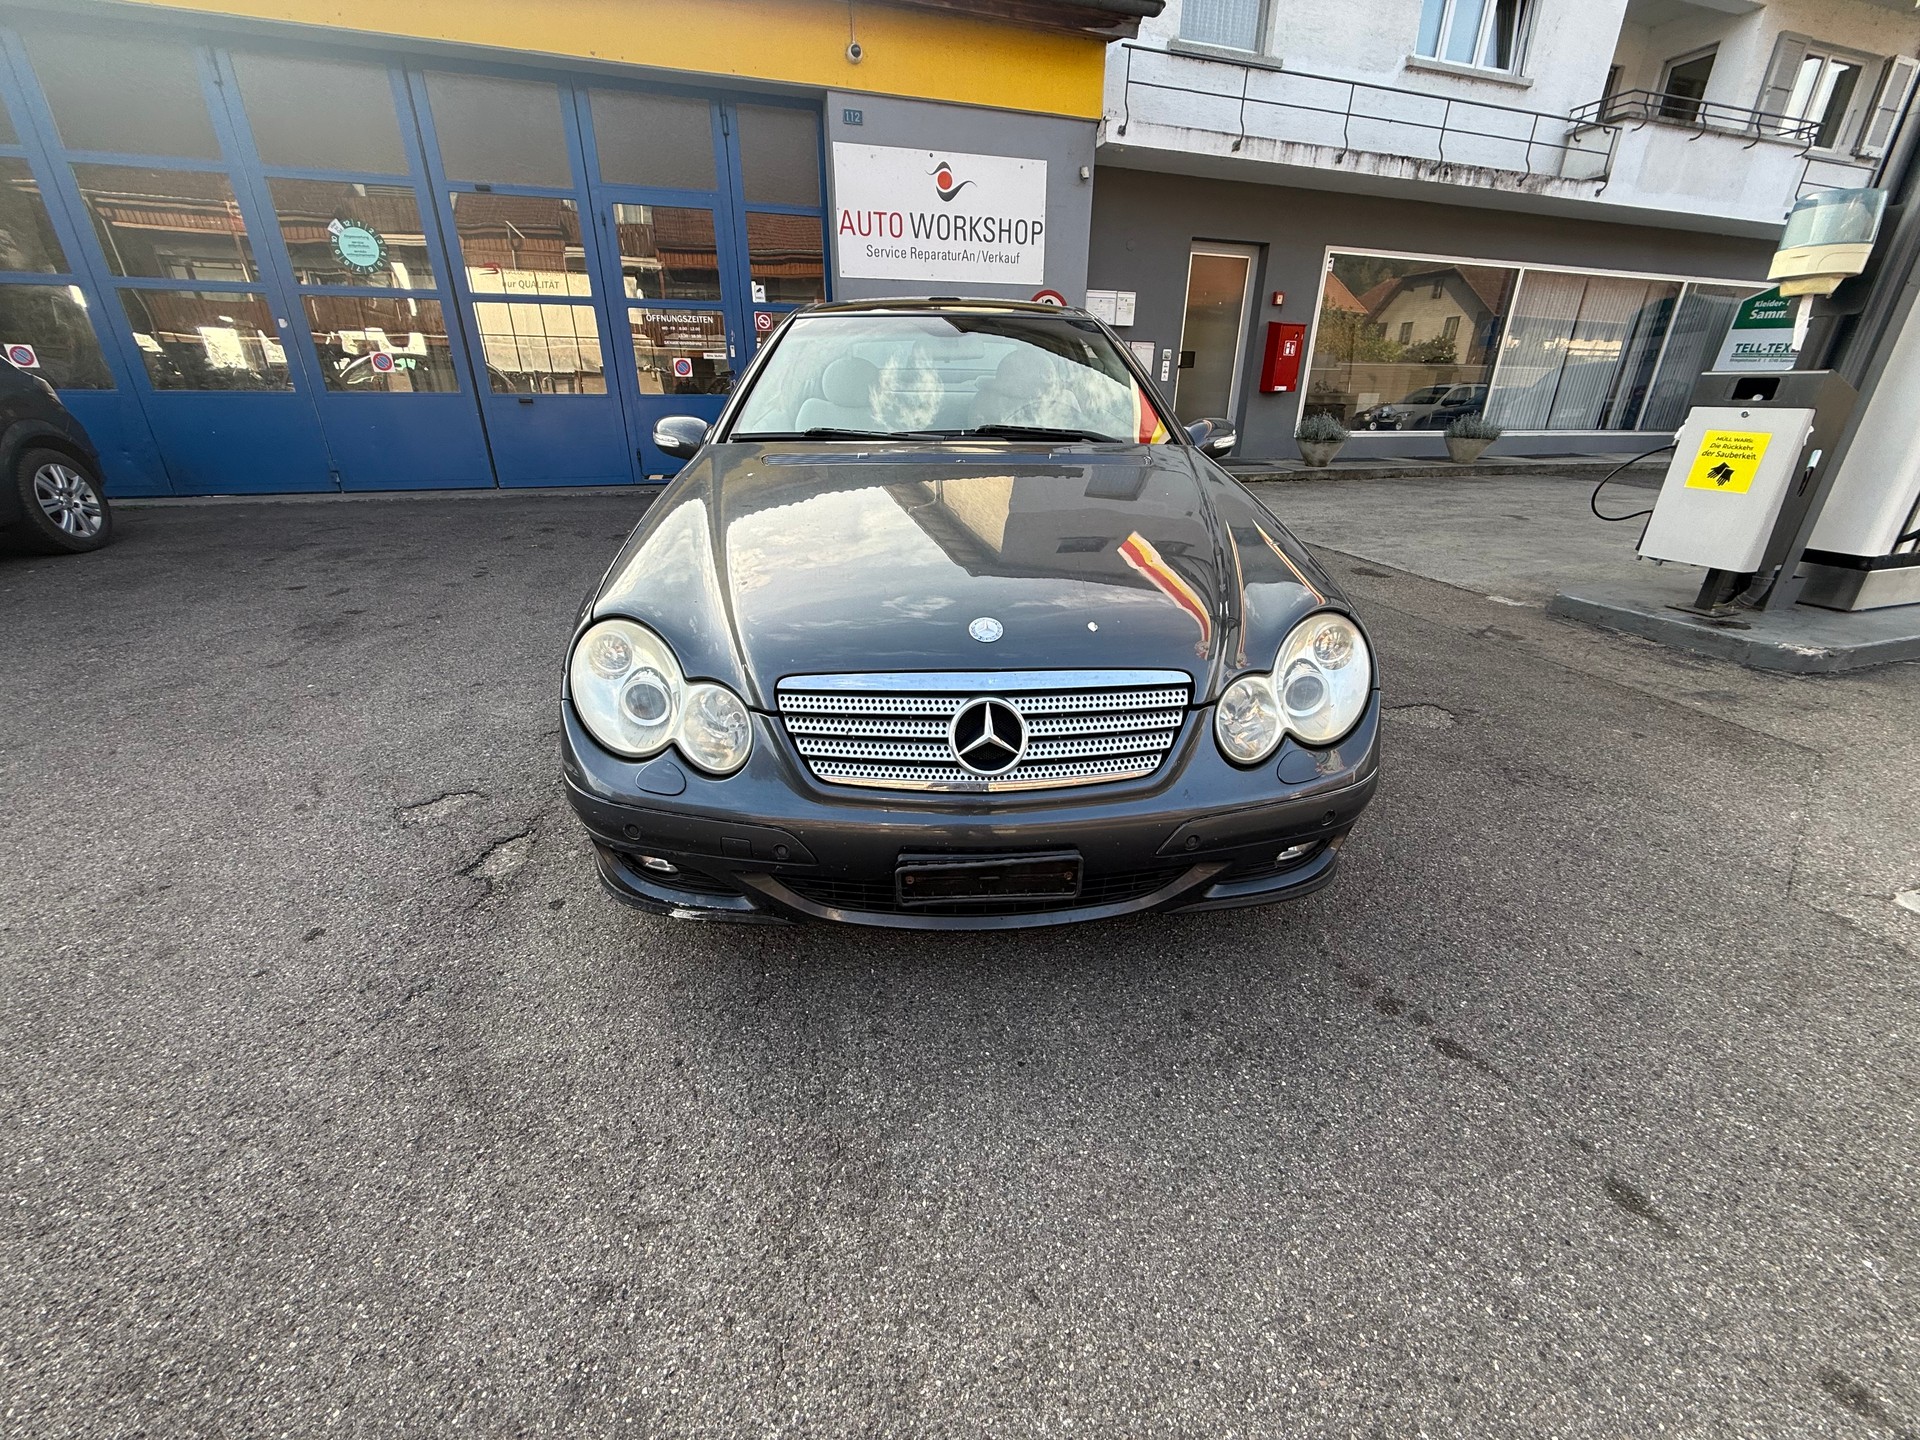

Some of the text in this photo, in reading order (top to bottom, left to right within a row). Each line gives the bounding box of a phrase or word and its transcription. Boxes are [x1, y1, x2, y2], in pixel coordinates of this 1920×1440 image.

[845, 111, 860, 122] 112
[839, 209, 1044, 246] AUTO WORKSHOP
[866, 244, 907, 259] Service
[645, 313, 714, 324] ÖFFNUNGSZEITEN
[1735, 342, 1793, 353] TELL-TEX
[1722, 443, 1754, 451] Rückkehr
[1701, 449, 1757, 460] der Sauberkeit
